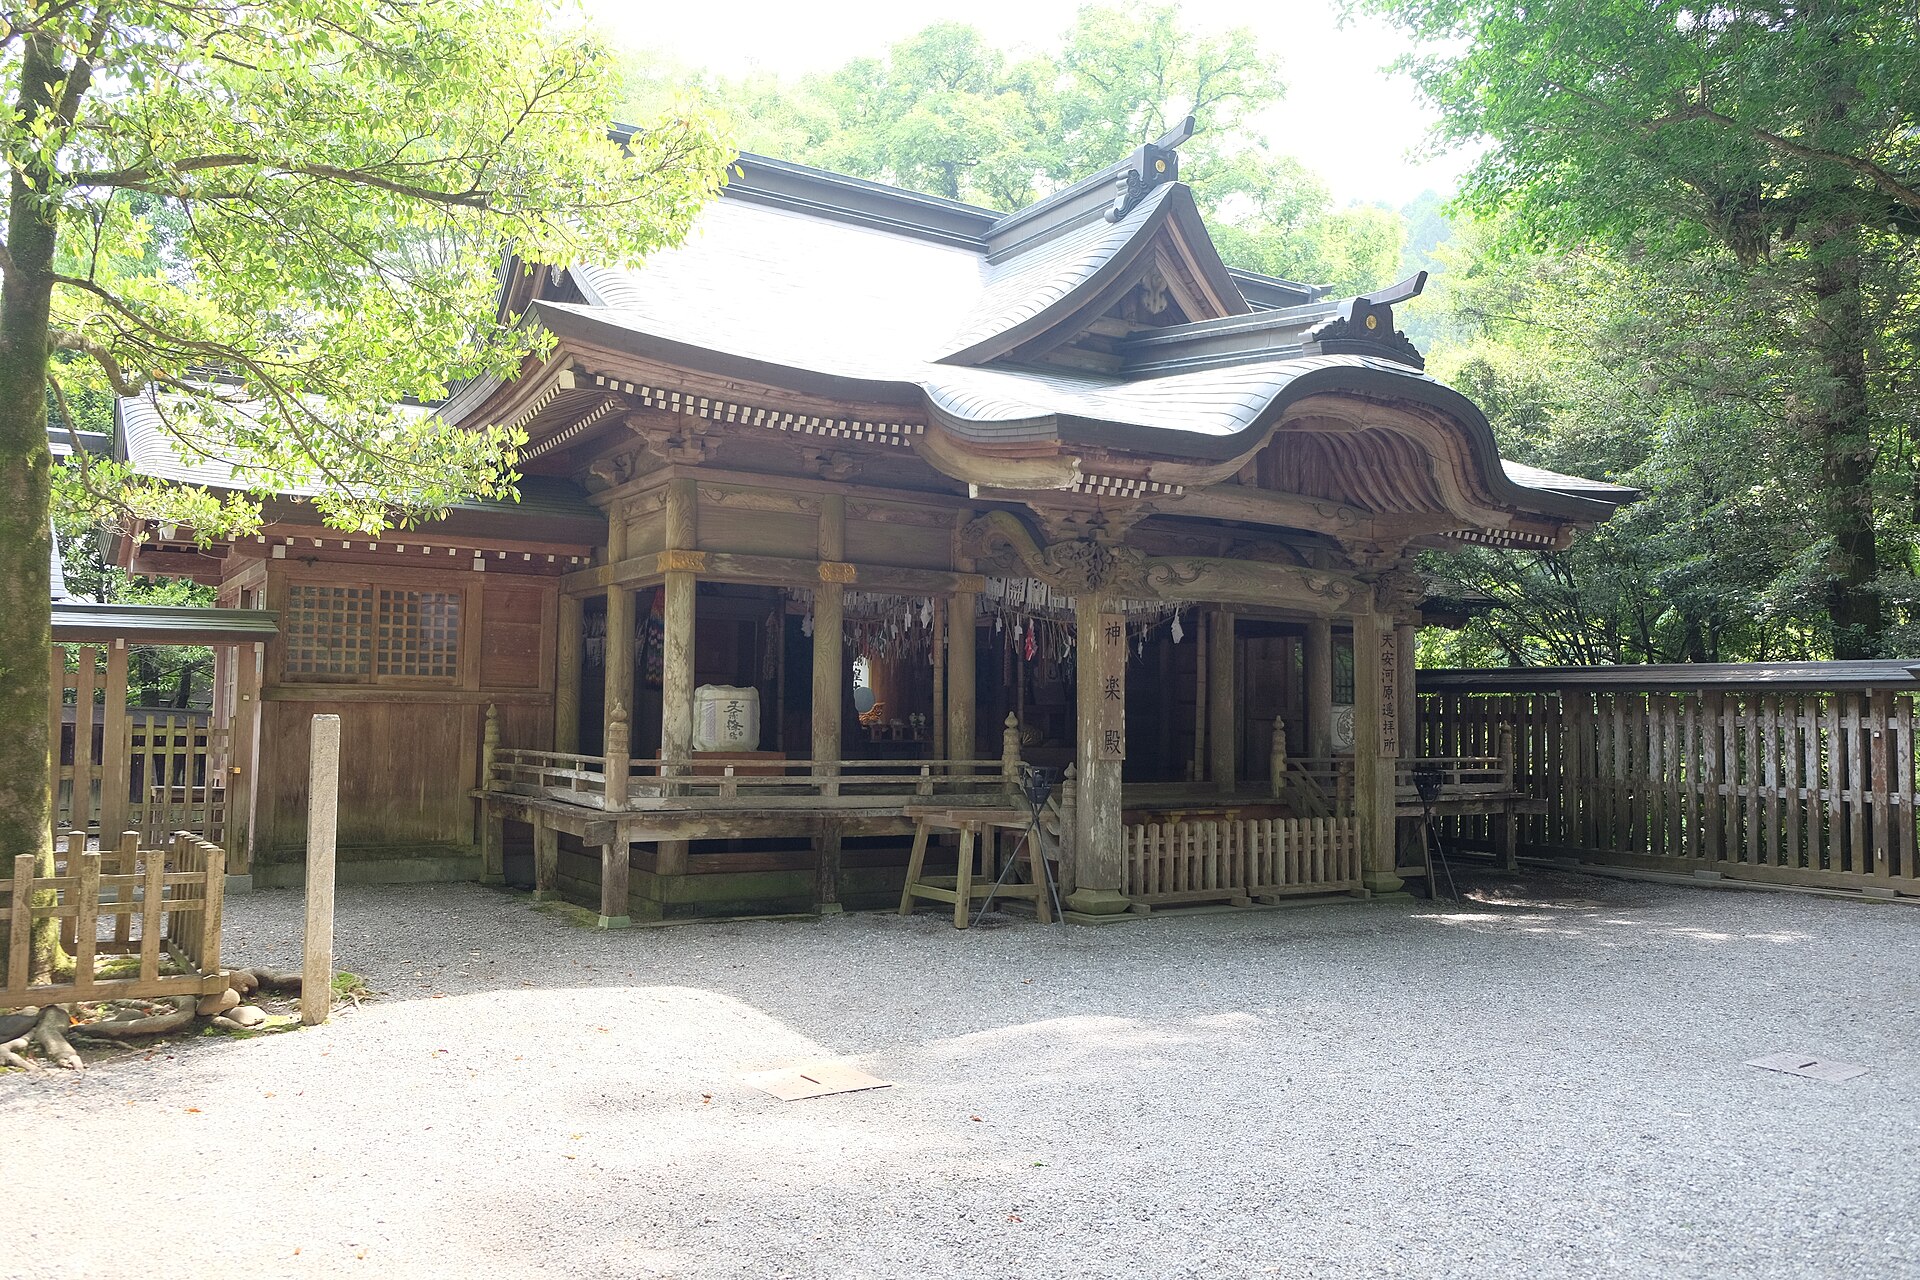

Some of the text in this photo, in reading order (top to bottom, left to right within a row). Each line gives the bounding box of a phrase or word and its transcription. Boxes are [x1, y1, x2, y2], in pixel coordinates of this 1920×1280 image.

[1104, 621, 1121, 754] 神楽殿
[1380, 633, 1396, 752] 天安河原遥拝所
